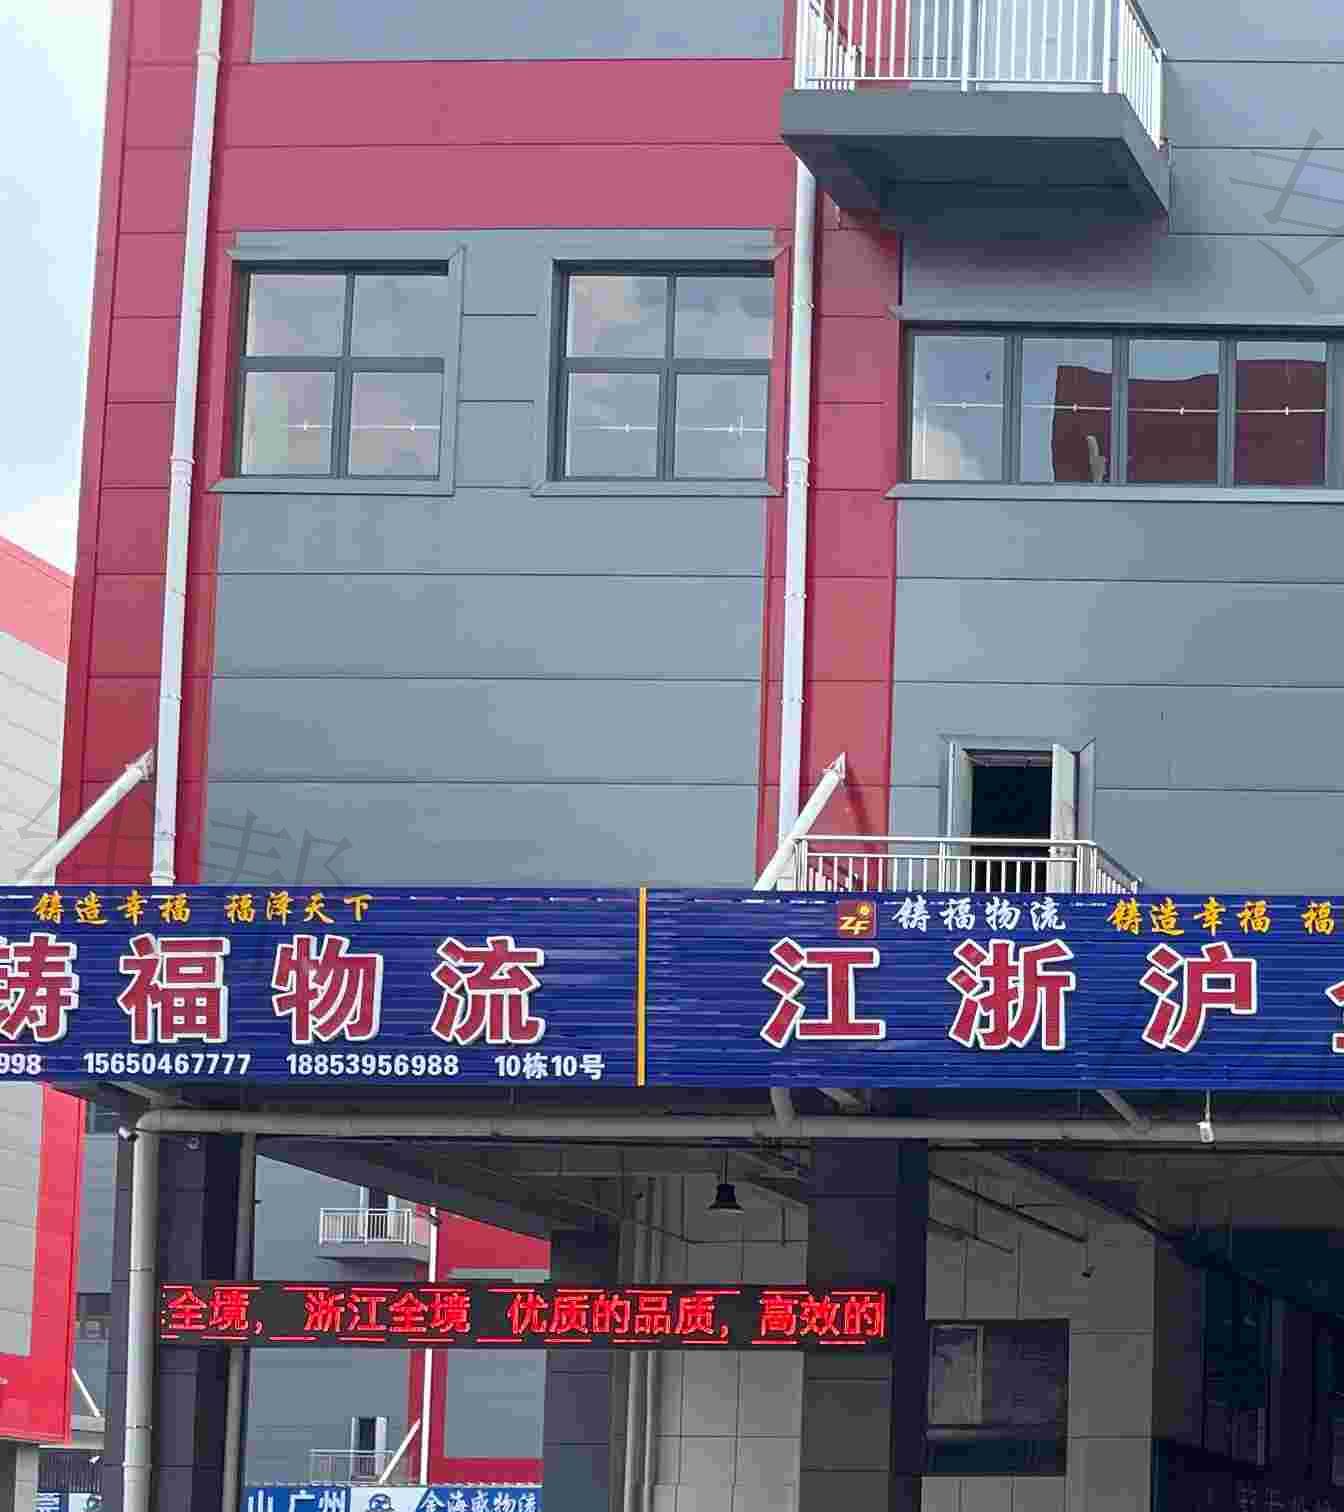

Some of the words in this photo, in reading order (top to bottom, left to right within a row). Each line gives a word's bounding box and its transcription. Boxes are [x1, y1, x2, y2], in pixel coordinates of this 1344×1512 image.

[83, 1053, 250, 1074] 15650467777
[286, 1053, 459, 1076] 18853956988
[494, 1053, 605, 1080] 10栋10号
[303, 1289, 471, 1334] 浙江全境
